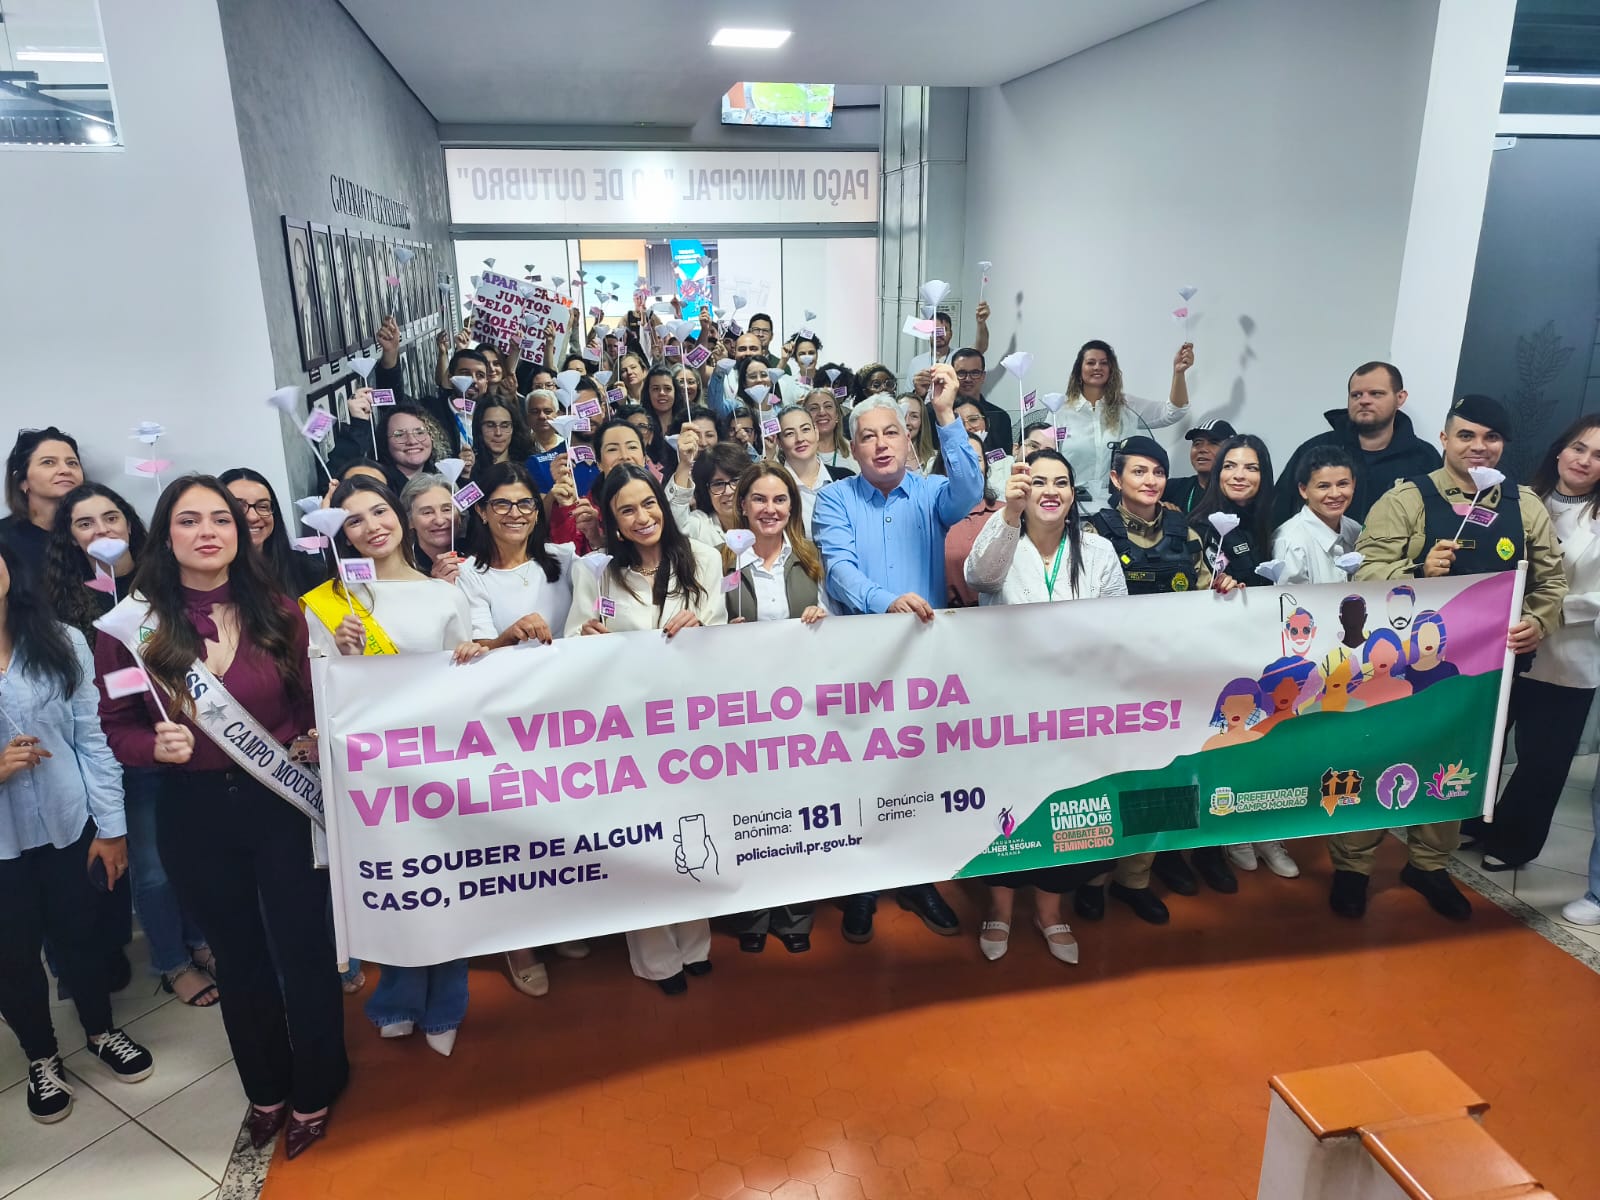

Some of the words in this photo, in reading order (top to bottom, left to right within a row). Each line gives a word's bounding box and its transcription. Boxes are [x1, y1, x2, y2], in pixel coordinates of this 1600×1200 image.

[496, 290, 551, 315] JUNTOS
[476, 308, 547, 340] VIOLÊNCI
[184, 669, 209, 700] SS
[223, 721, 275, 768] CAMPO
[346, 720, 496, 772] PELA
[507, 704, 635, 752] VIDA
[645, 699, 676, 736] E
[687, 686, 803, 731] PELO
[815, 679, 895, 717] FIM
[906, 674, 970, 711] DA
[348, 754, 647, 827] VIOLÊNCIA
[657, 730, 853, 785] CONTRA
[862, 725, 926, 761] AS
[936, 699, 1183, 754] MULHERES!
[876, 792, 935, 809] Denúncia
[940, 787, 986, 813] 190
[1050, 793, 1111, 817] PARANÁ
[1236, 801, 1268, 811] CAMPO
[1237, 787, 1293, 803] PREFEITURA
[1294, 787, 1308, 798] DE
[732, 808, 793, 827] Denúncia
[798, 803, 843, 831] 181
[877, 808, 917, 822] crime:
[1051, 812, 1098, 831] UNIDO
[1098, 813, 1111, 823] NO
[734, 823, 792, 841] anônima:
[1055, 828, 1097, 841] COMBATE
[1098, 826, 1111, 836] AO
[359, 860, 394, 881] SE
[402, 843, 521, 878] SOUBER
[529, 837, 566, 861] DE
[573, 821, 664, 853] ALGUM
[735, 834, 863, 866] policiacivil.pr.gov.br
[980, 844, 1008, 855] ULHER
[1009, 841, 1042, 851] SEGURA
[362, 886, 451, 912] CASO,
[459, 862, 609, 900] DENUNCIE.
